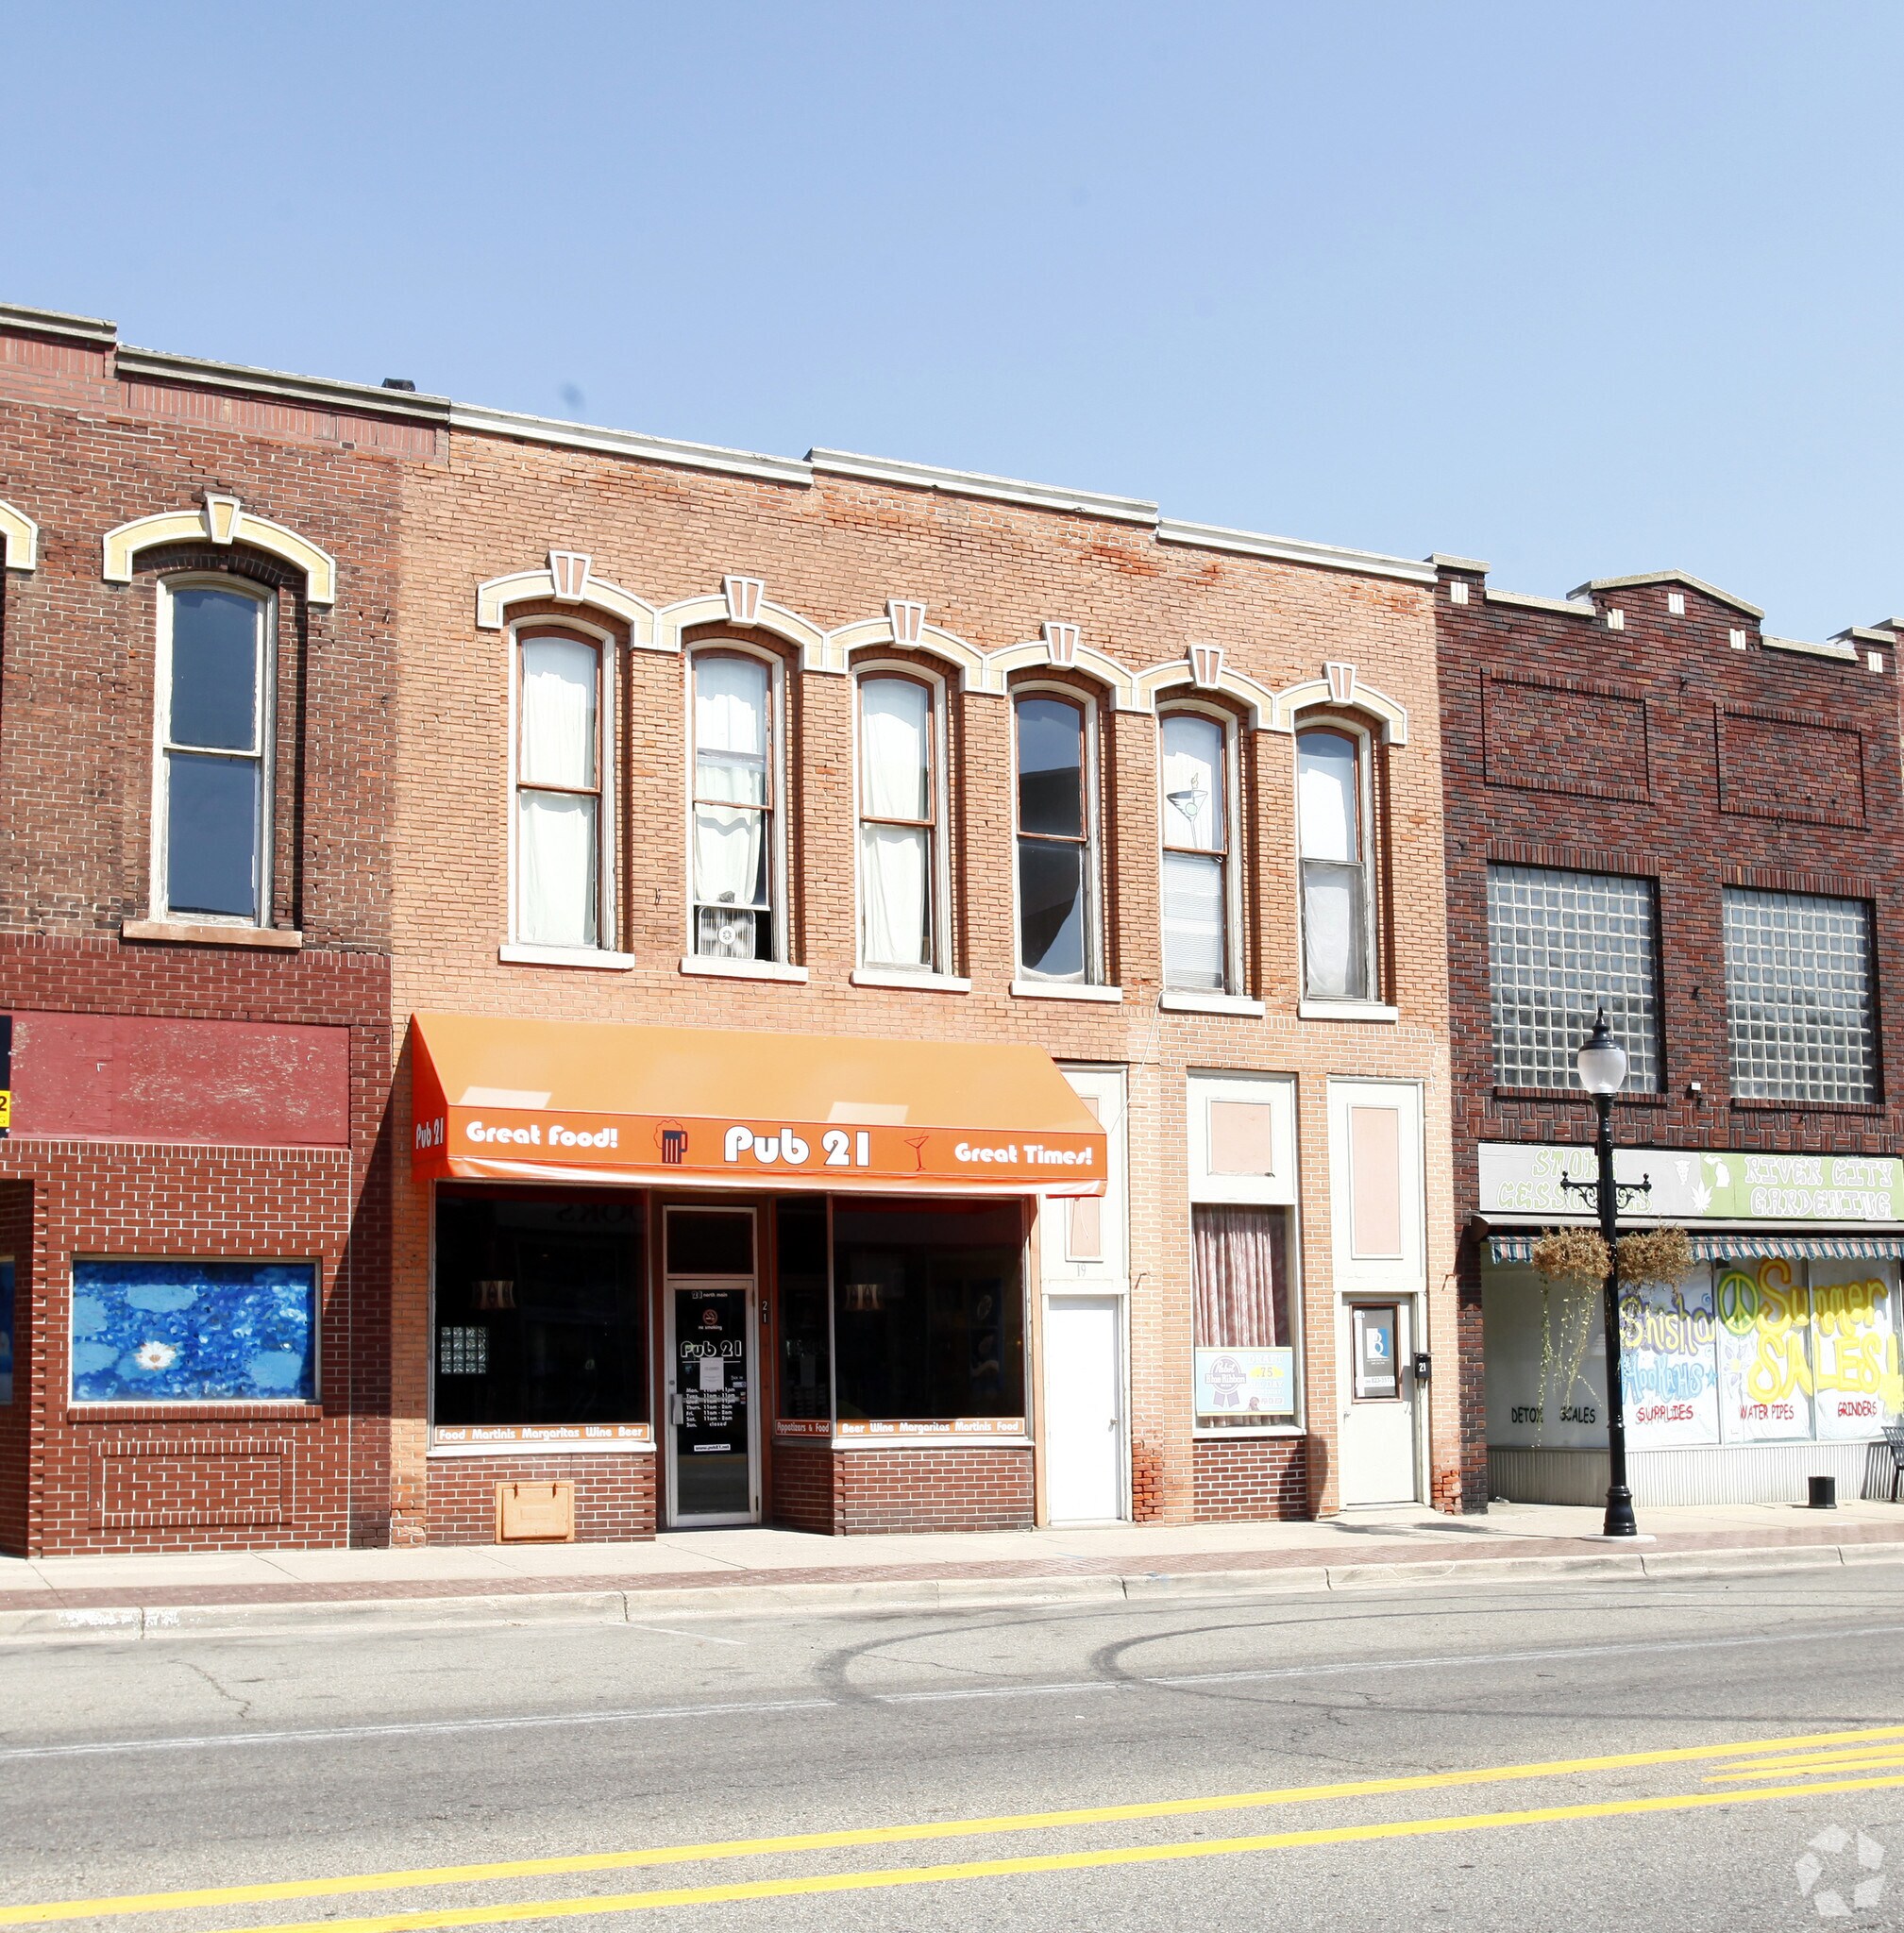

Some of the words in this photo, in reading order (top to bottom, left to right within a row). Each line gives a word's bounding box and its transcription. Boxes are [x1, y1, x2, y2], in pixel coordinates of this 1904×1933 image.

[415, 1119, 431, 1151] Pub
[433, 1117, 444, 1145] 21
[465, 1120, 541, 1145] Great
[548, 1124, 618, 1149] Food!
[723, 1124, 810, 1166] Pub
[820, 1128, 870, 1168] 21
[954, 1142, 1018, 1163] Great
[1022, 1145, 1093, 1166] Times!
[1532, 1148, 1618, 1179] SMOK
[1744, 1155, 1824, 1185] RIVER
[1831, 1157, 1893, 1187] CITY
[1750, 1186, 1892, 1219] GARDENING
[1076, 1263, 1087, 1277] 19
[1757, 1259, 1888, 1336] Summer
[1618, 1292, 1716, 1356] Shisha
[681, 1340, 716, 1357] Pub
[720, 1340, 742, 1356] 21
[1418, 1363, 1426, 1372] 21
[1511, 1406, 1543, 1423] DETOX
[1560, 1406, 1595, 1424] SCALES
[1636, 1404, 1693, 1424] SUPPLIES
[1740, 1404, 1769, 1420] WATER
[1772, 1404, 1794, 1420] PIPES
[1837, 1401, 1878, 1418] GRINDERS
[439, 1429, 465, 1440] Food
[472, 1428, 515, 1440] Martinis
[522, 1427, 580, 1441] Margaritas
[585, 1426, 612, 1437] Wine
[618, 1425, 643, 1437] Beer
[777, 1422, 806, 1434] Appetizers
[816, 1422, 830, 1433] Food
[842, 1423, 865, 1434] Beer
[870, 1422, 894, 1433] Wine
[900, 1421, 950, 1434] Margaritas
[954, 1421, 992, 1432] Martinis
[997, 1420, 1019, 1431] Food
